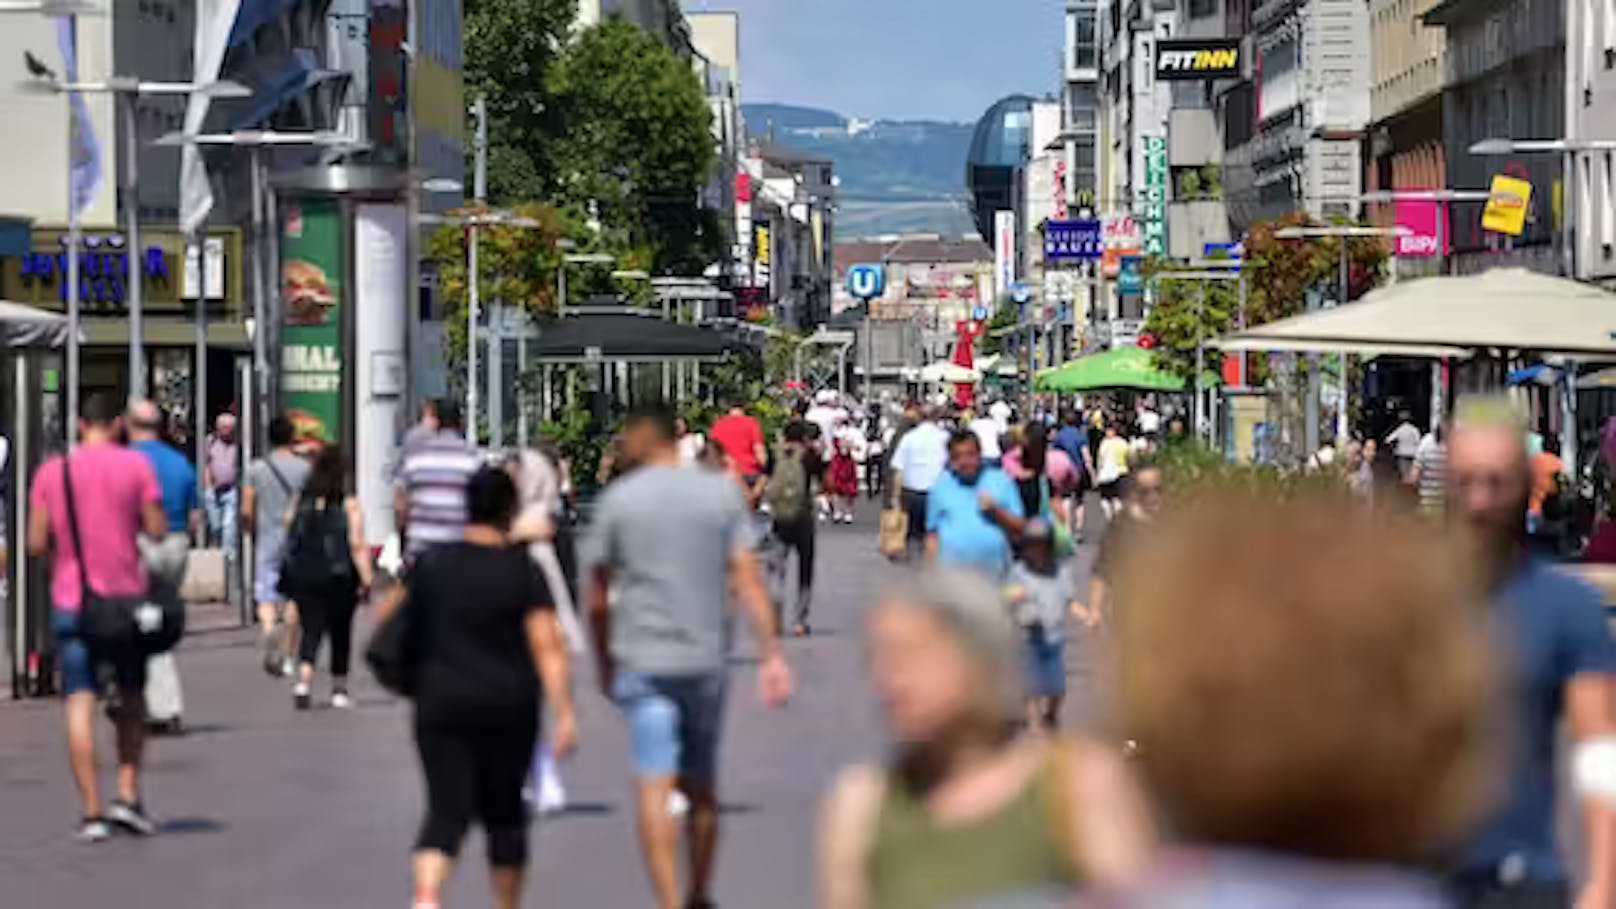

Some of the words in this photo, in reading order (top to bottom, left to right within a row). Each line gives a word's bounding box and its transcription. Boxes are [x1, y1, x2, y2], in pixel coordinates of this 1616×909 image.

[1159, 49, 1238, 71] FITINN
[1146, 137, 1162, 254] DEICHMA
[853, 270, 875, 297] U
